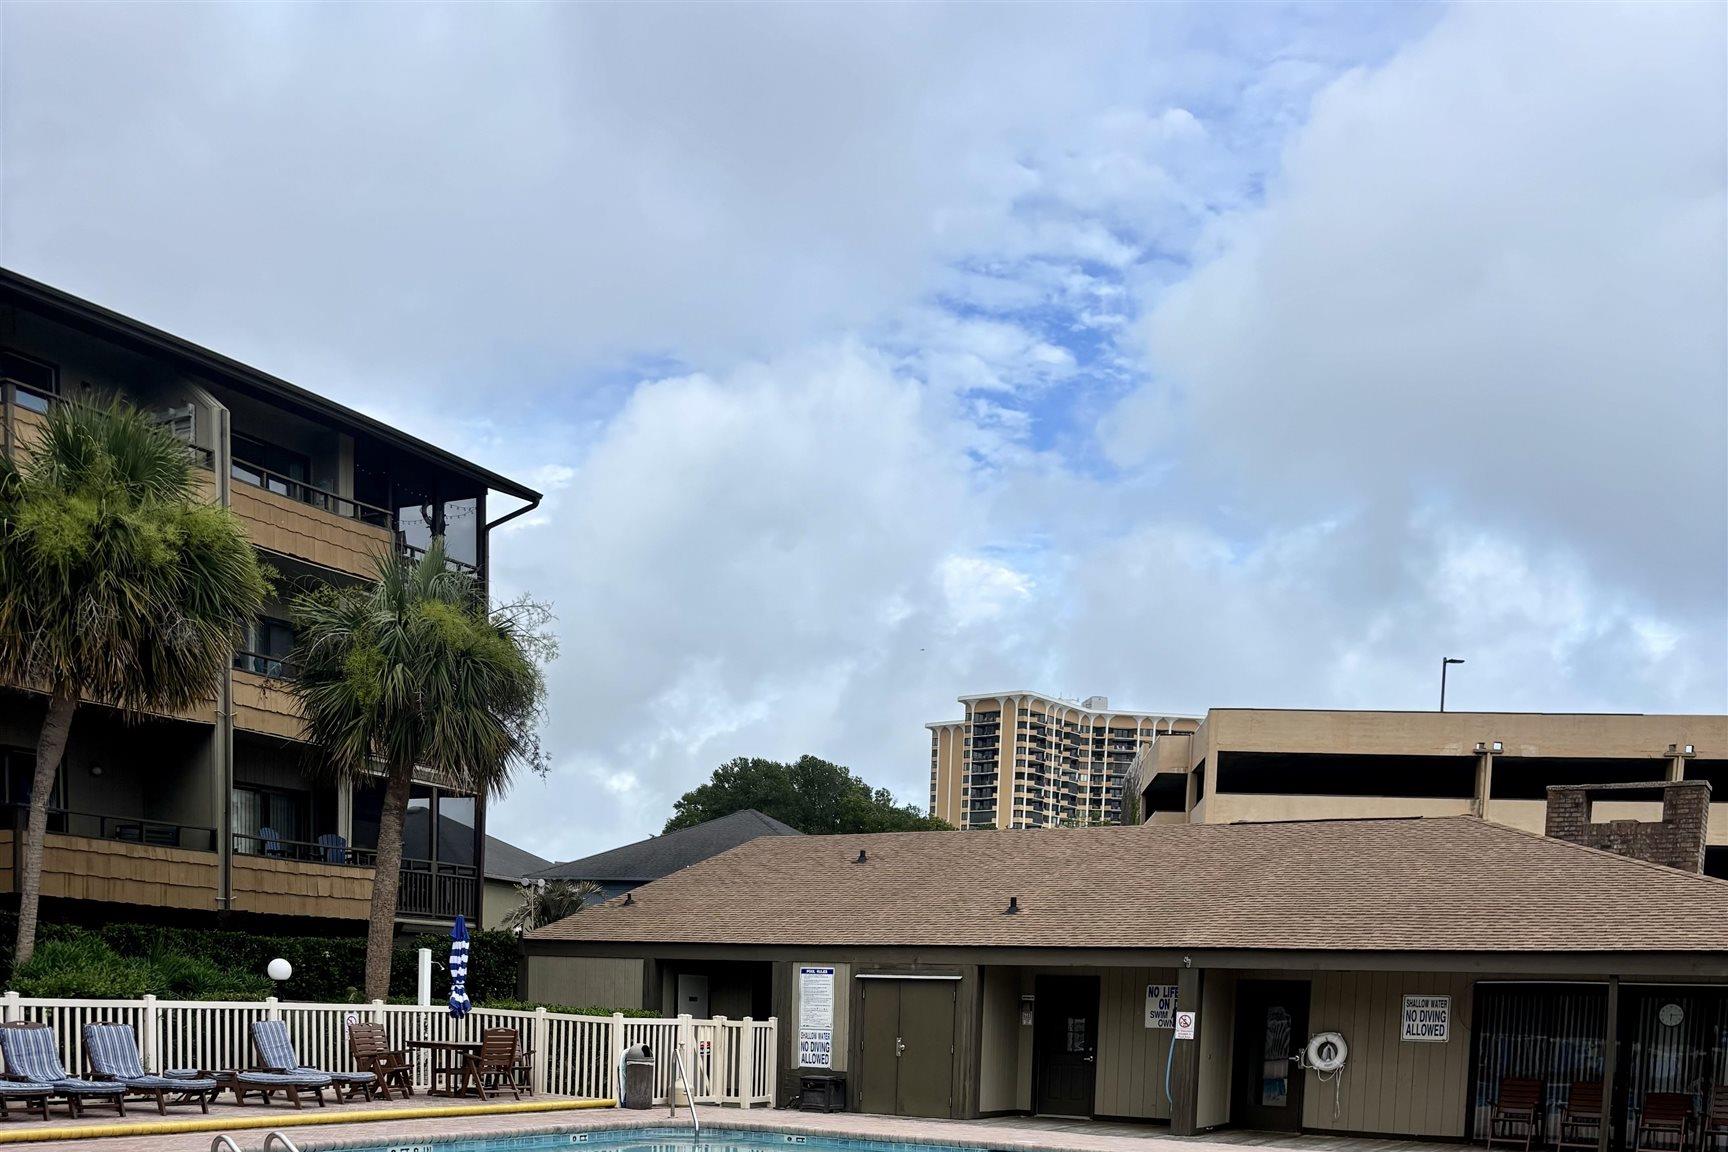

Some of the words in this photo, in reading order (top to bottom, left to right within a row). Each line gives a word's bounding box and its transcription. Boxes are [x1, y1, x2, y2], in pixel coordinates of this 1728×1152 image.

[1148, 986, 1160, 998] NO
[1158, 998, 1170, 1010] ON
[1405, 998, 1429, 1008] SHALLOW
[1430, 999, 1447, 1009] WATER
[1150, 1010, 1168, 1019] SWIM
[1405, 1009, 1417, 1022] NO
[1419, 1010, 1446, 1023] DIVING
[1405, 1024, 1445, 1037] ALLOWED
[800, 1041, 809, 1052] NO
[810, 1041, 830, 1053] DIVING
[800, 1053, 830, 1065] ALLOWED
